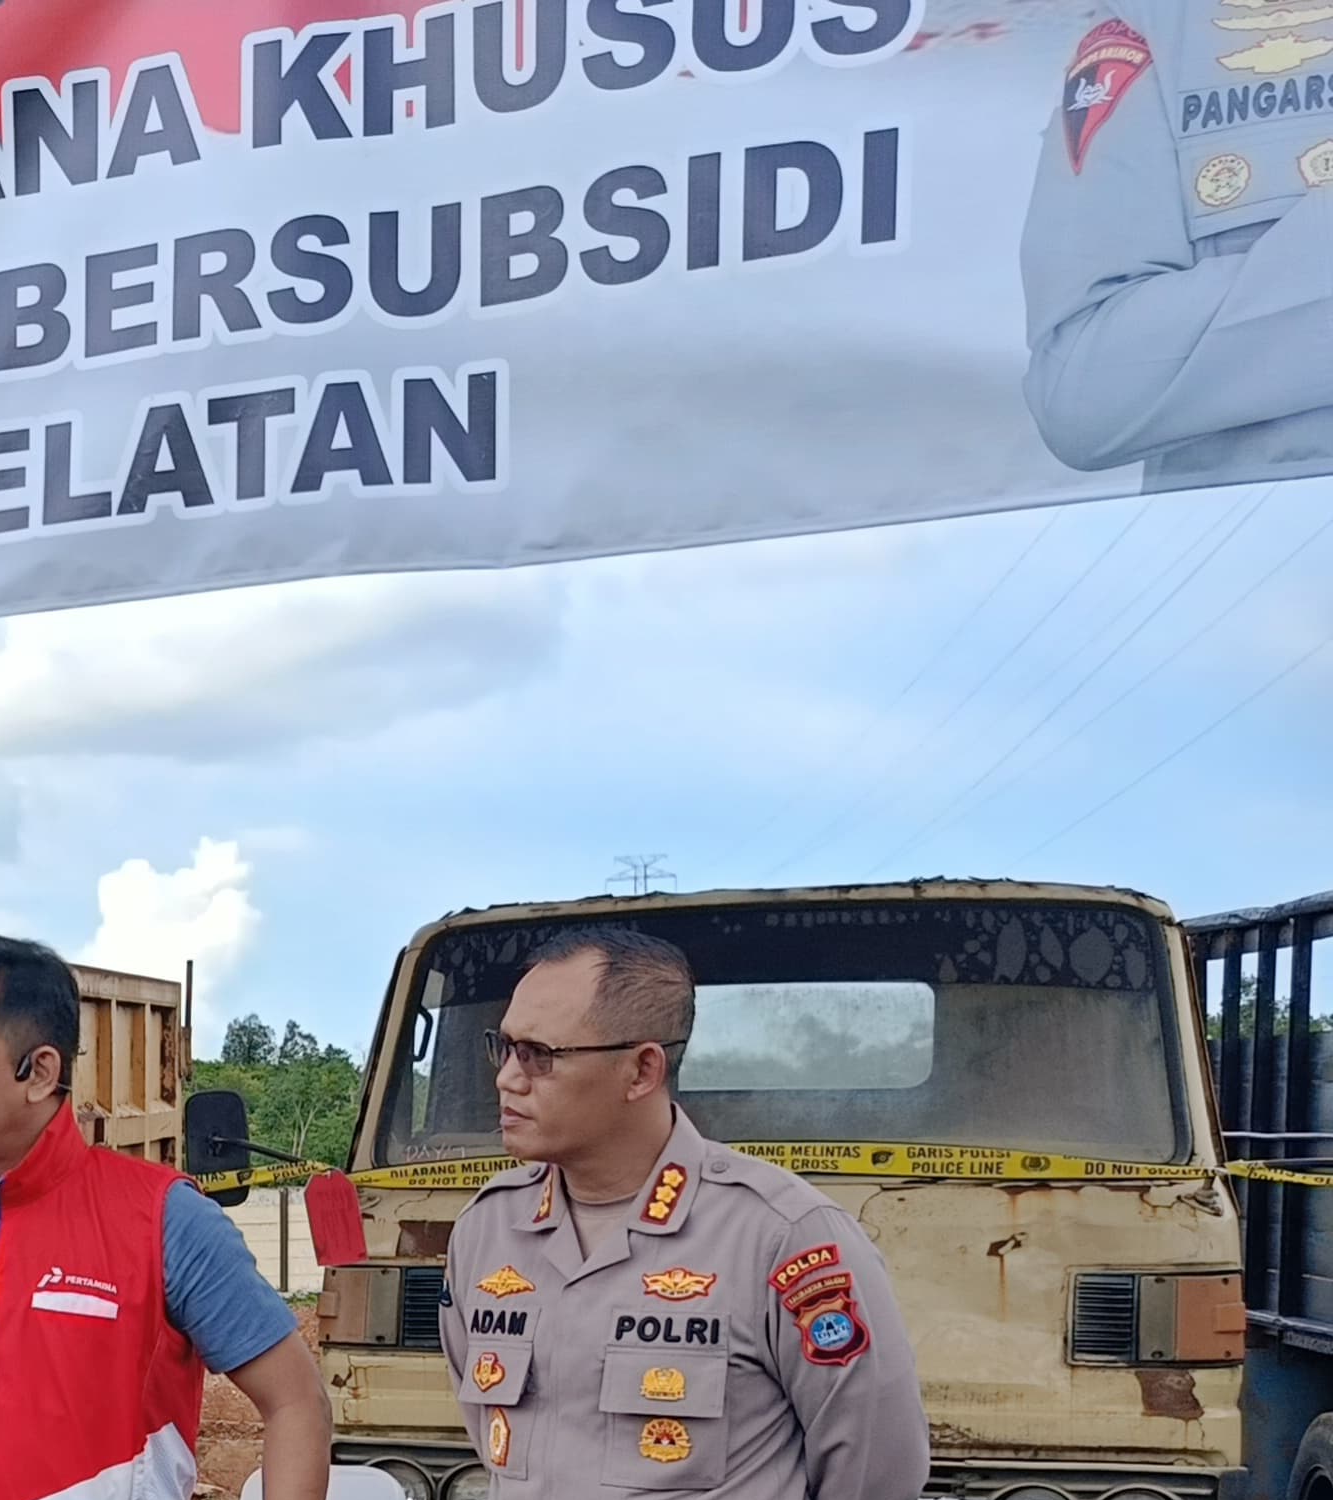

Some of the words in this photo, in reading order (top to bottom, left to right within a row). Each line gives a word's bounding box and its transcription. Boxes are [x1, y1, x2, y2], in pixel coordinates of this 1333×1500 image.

[737, 1145, 785, 1158] ARANG
[789, 1145, 861, 1158] MELINTAS
[906, 1146, 954, 1159] GARIS
[389, 1163, 456, 1179] DILARANG
[790, 1159, 839, 1171] CROSS
[911, 1161, 964, 1175] POLICE
[969, 1161, 1004, 1176] LINE
[1084, 1161, 1105, 1176] DO
[408, 1176, 426, 1186] DO
[431, 1176, 459, 1186] NOT
[463, 1175, 489, 1187] CRO
[776, 1249, 832, 1286] POLDA
[64, 1275, 118, 1294] PERTAMINA
[470, 1307, 527, 1337] ADAM
[615, 1315, 721, 1345] POLRI
